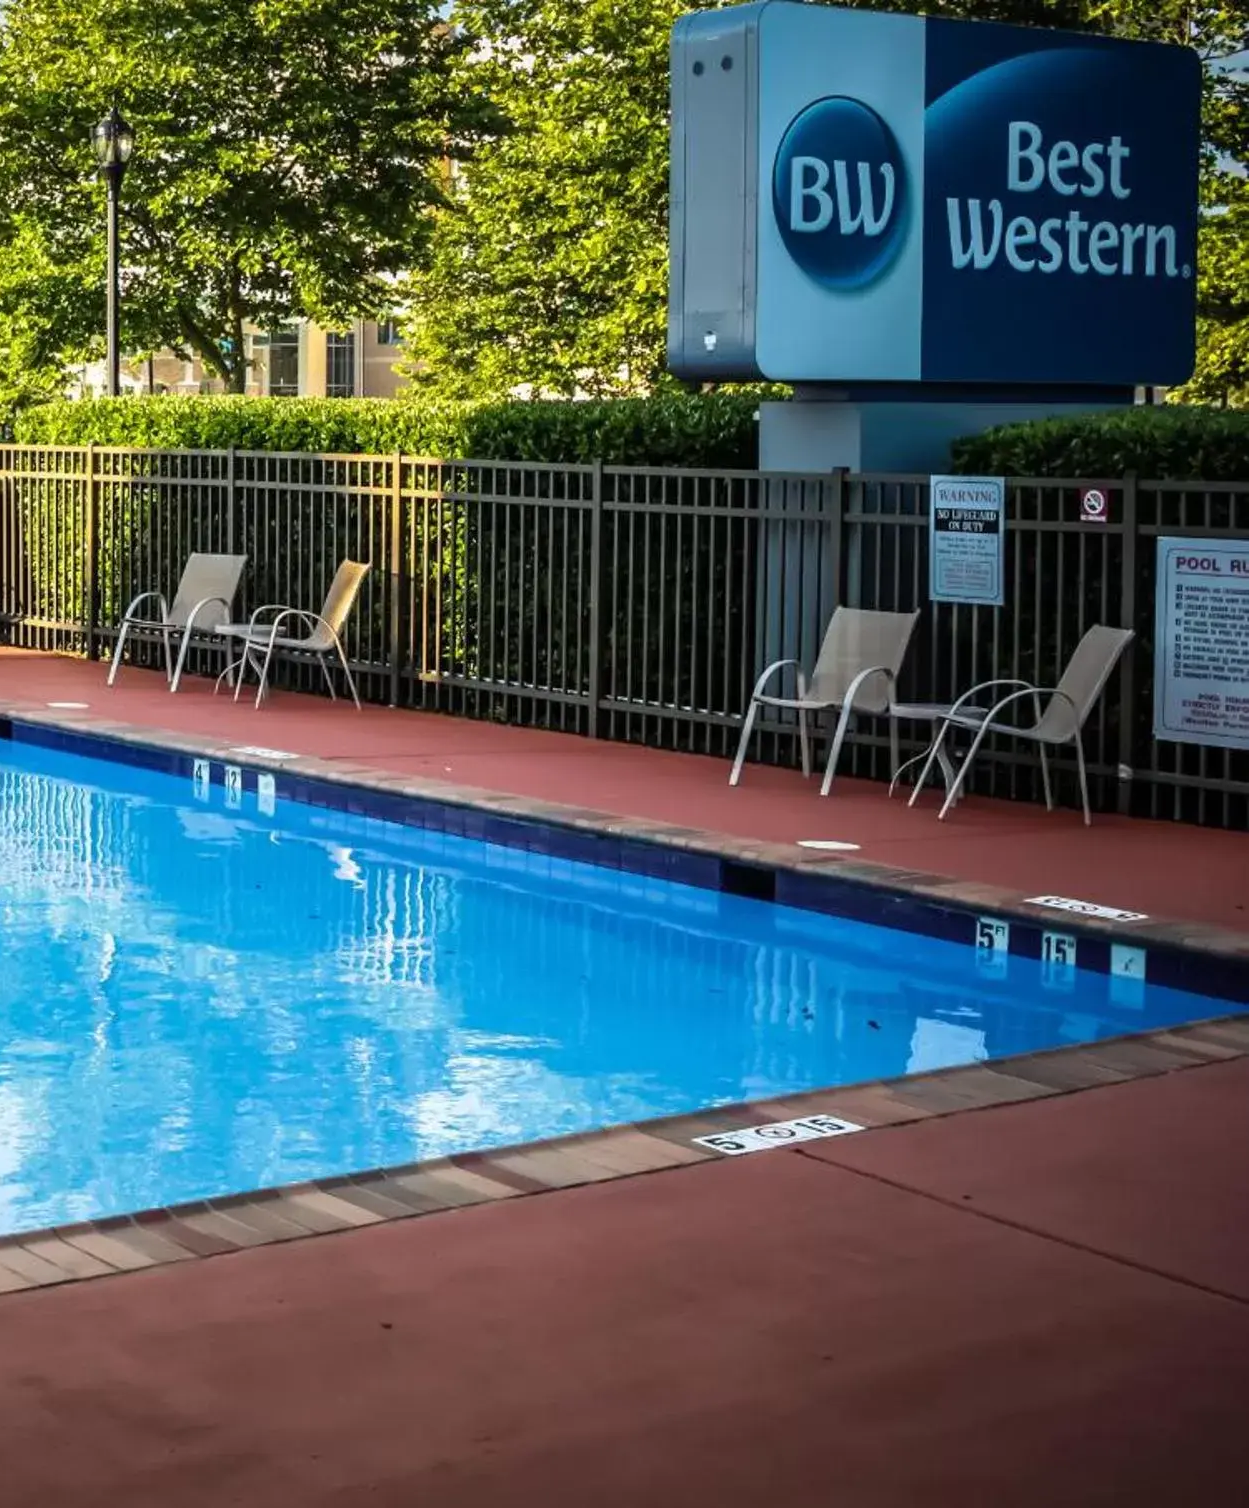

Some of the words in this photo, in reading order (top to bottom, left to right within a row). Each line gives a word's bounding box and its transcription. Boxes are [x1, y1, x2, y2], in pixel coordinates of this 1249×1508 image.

[1007, 120, 1131, 199] Best
[790, 156, 895, 238] BW
[938, 489, 997, 503] WARNING
[937, 509, 950, 520] NO
[952, 509, 997, 521] LIFEGUARD
[948, 521, 960, 530] ON
[962, 521, 985, 532] DUTY
[1175, 556, 1221, 571] POOL
[979, 923, 994, 949] 5
[1045, 936, 1067, 965] 15
[704, 1136, 747, 1151] 5
